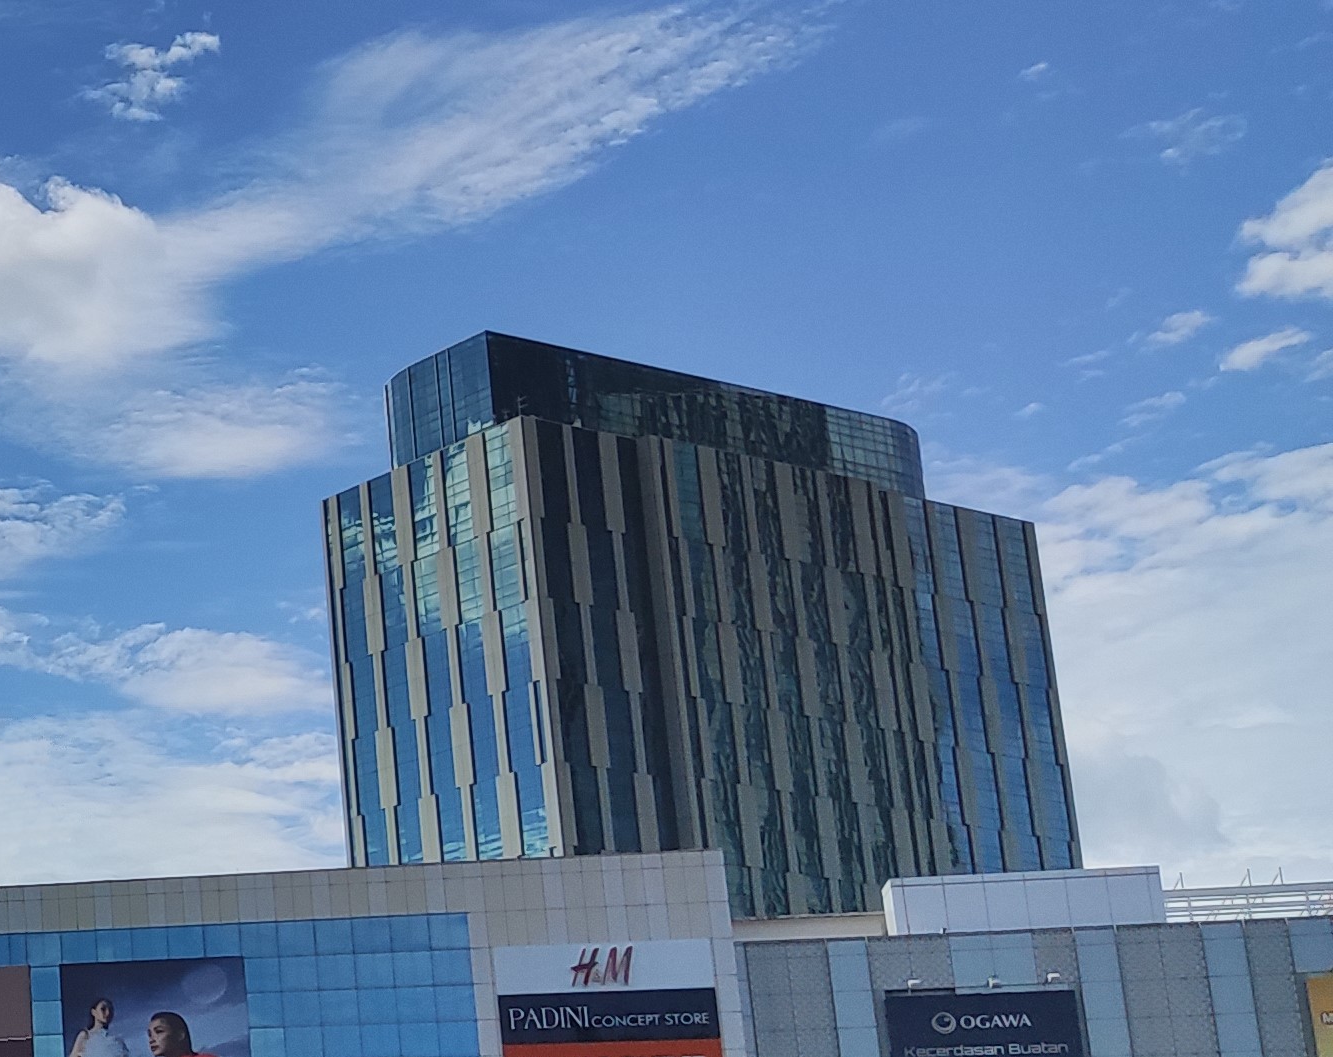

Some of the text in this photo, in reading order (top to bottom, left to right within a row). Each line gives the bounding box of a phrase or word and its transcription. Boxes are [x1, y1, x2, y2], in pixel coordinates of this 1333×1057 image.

[570, 945, 633, 987] H&M
[509, 1005, 710, 1030] PADINI CONCEPT STORE
[959, 1013, 1032, 1030] OGAWA
[904, 1042, 1069, 1057] Kecerdasan Buatan
